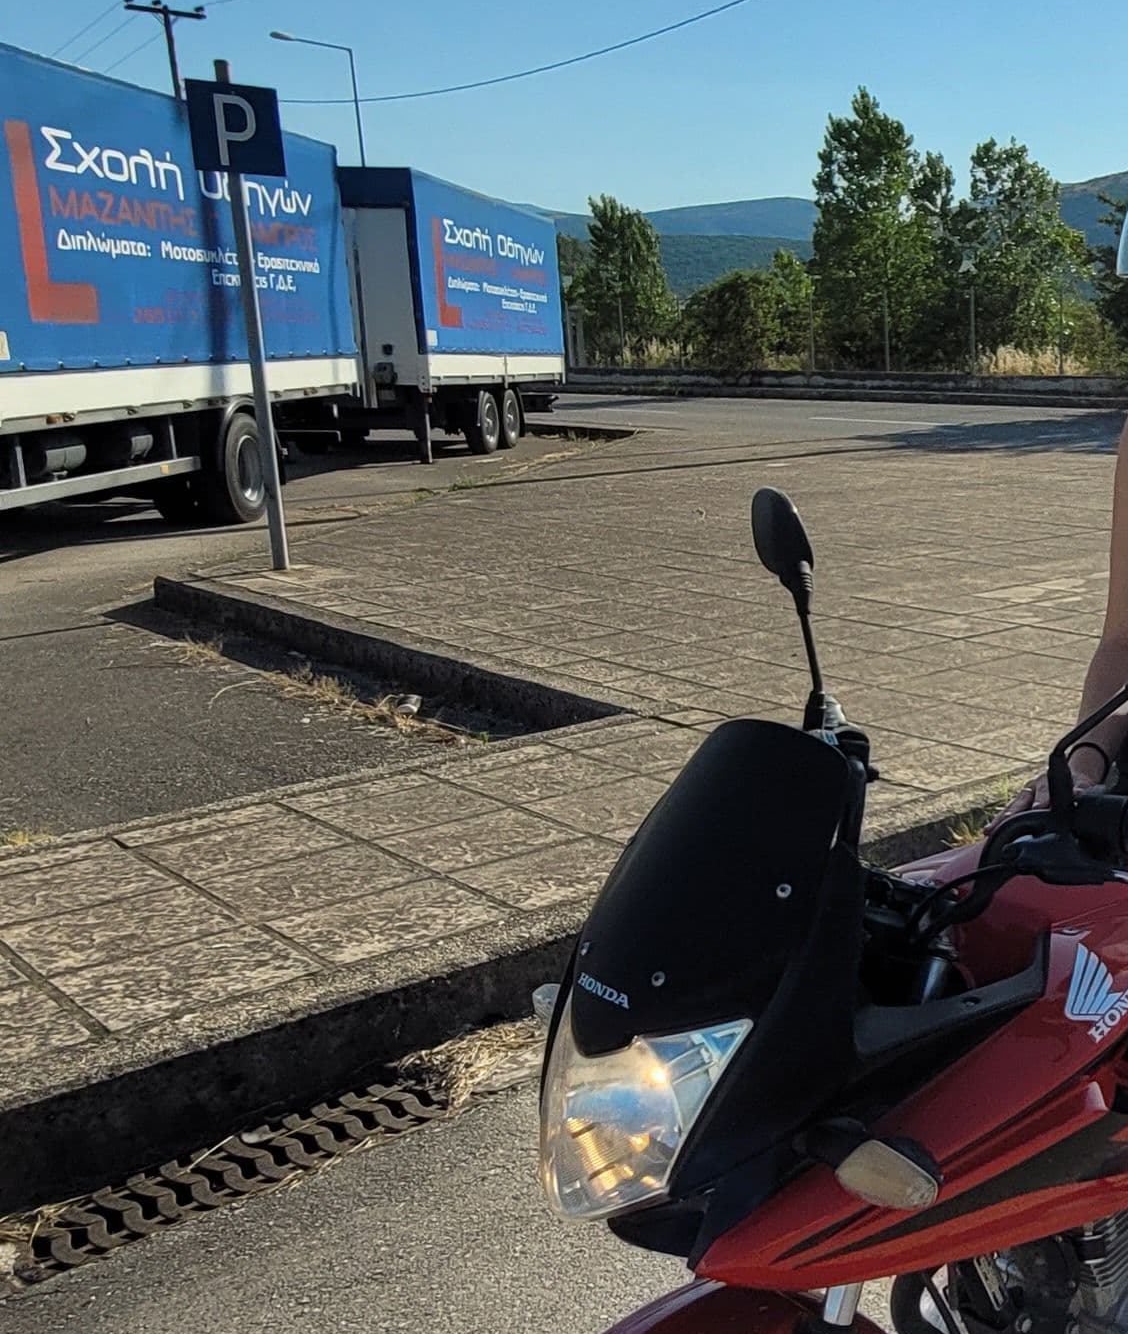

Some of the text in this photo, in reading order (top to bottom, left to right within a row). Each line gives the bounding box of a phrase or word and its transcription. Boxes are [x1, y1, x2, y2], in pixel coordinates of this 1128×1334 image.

[213, 93, 256, 166] P
[40, 126, 184, 201] Σχολή
[443, 218, 492, 257] Σχολή
[497, 234, 545, 266] Οδηγών
[578, 971, 630, 1010] HONDA
